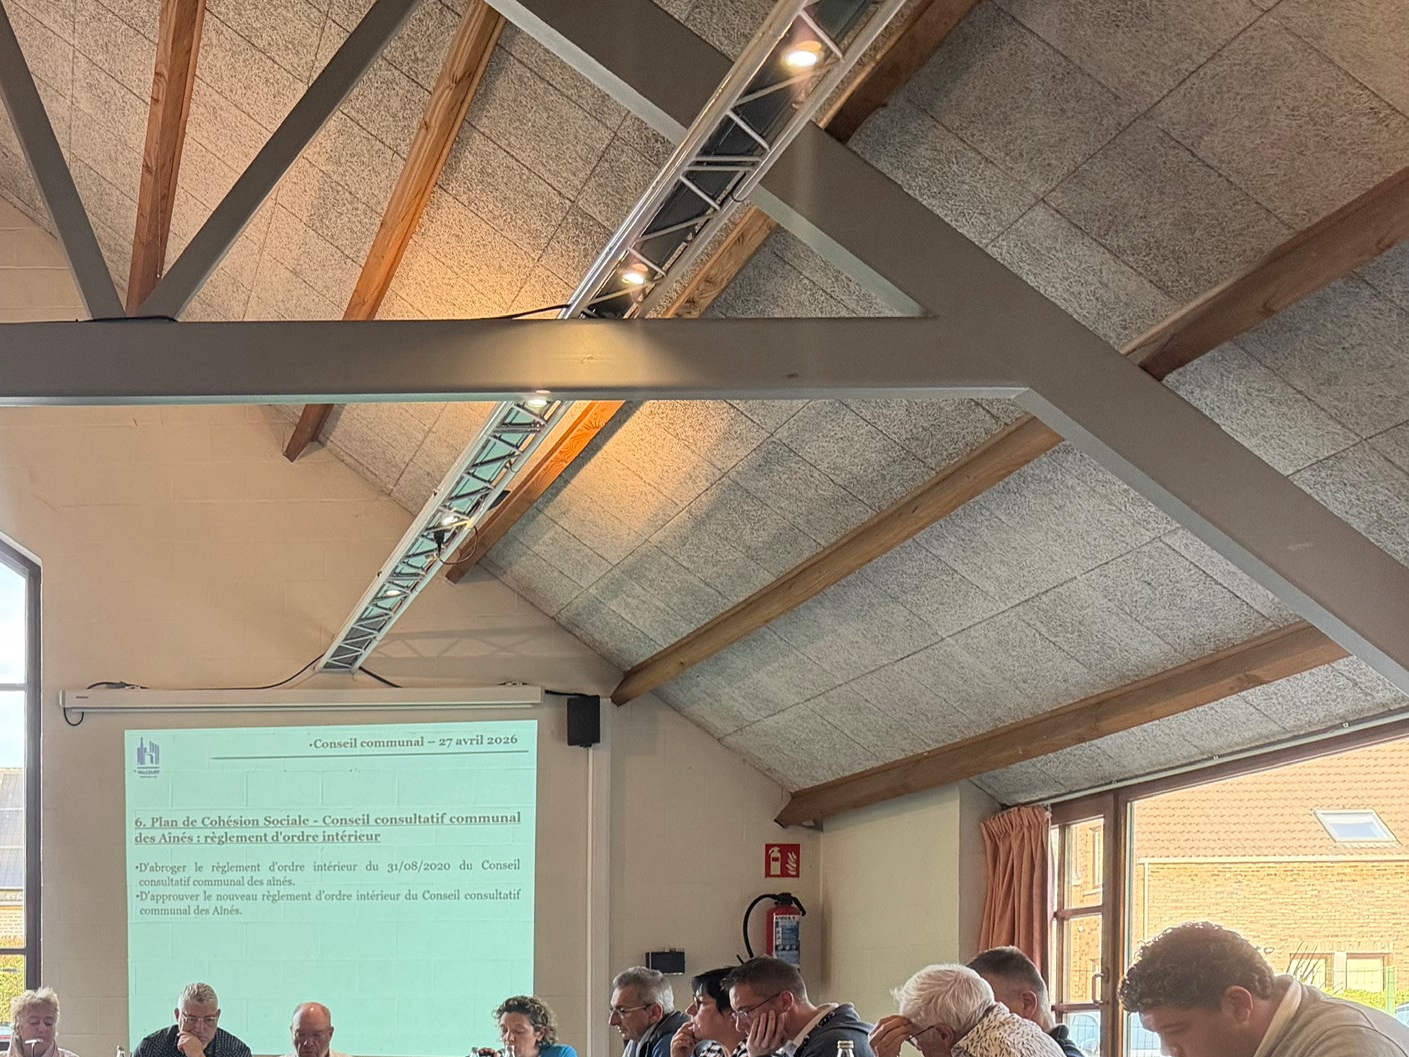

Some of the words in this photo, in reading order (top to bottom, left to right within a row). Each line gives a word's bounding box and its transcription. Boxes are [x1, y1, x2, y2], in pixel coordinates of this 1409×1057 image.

[314, 738, 357, 749] Conseil
[360, 737, 424, 748] communal
[439, 738, 452, 748] 27
[455, 735, 483, 746] avril
[487, 734, 518, 745] 2026
[135, 817, 146, 827] 6.
[151, 816, 178, 828] Plan
[183, 816, 197, 827] de
[201, 815, 259, 827] Cohésion
[263, 815, 309, 827] Sociale
[323, 813, 370, 825] Conseil
[374, 812, 447, 825] consultatif
[449, 812, 521, 824] communal
[134, 832, 156, 843] des
[159, 831, 194, 843] Aînés
[204, 832, 267, 845] règlement
[271, 831, 319, 843] d'ordre
[322, 830, 381, 842] intérieur
[194, 861, 203, 872] le
[211, 861, 261, 874] règlement
[269, 861, 305, 872] d'ordre
[313, 861, 357, 872] intérieur
[365, 860, 379, 871] du
[387, 859, 451, 873] 31/08/2020
[459, 860, 473, 871] du
[481, 858, 521, 870] Conseil
[139, 876, 192, 887] consultatif
[192, 876, 245, 887] communal
[247, 876, 264, 886] des
[266, 876, 295, 886] aînés.
[203, 890, 212, 901] le
[216, 893, 258, 901] nouveau
[261, 890, 311, 903] règlement
[315, 890, 352, 901] d'ordre
[356, 890, 402, 901] intérieur
[404, 890, 418, 900] du
[422, 889, 460, 900] Conseil
[464, 888, 521, 900] consultatif
[140, 905, 191, 916] communal
[193, 905, 210, 915] des
[212, 904, 242, 915] Aînés.
